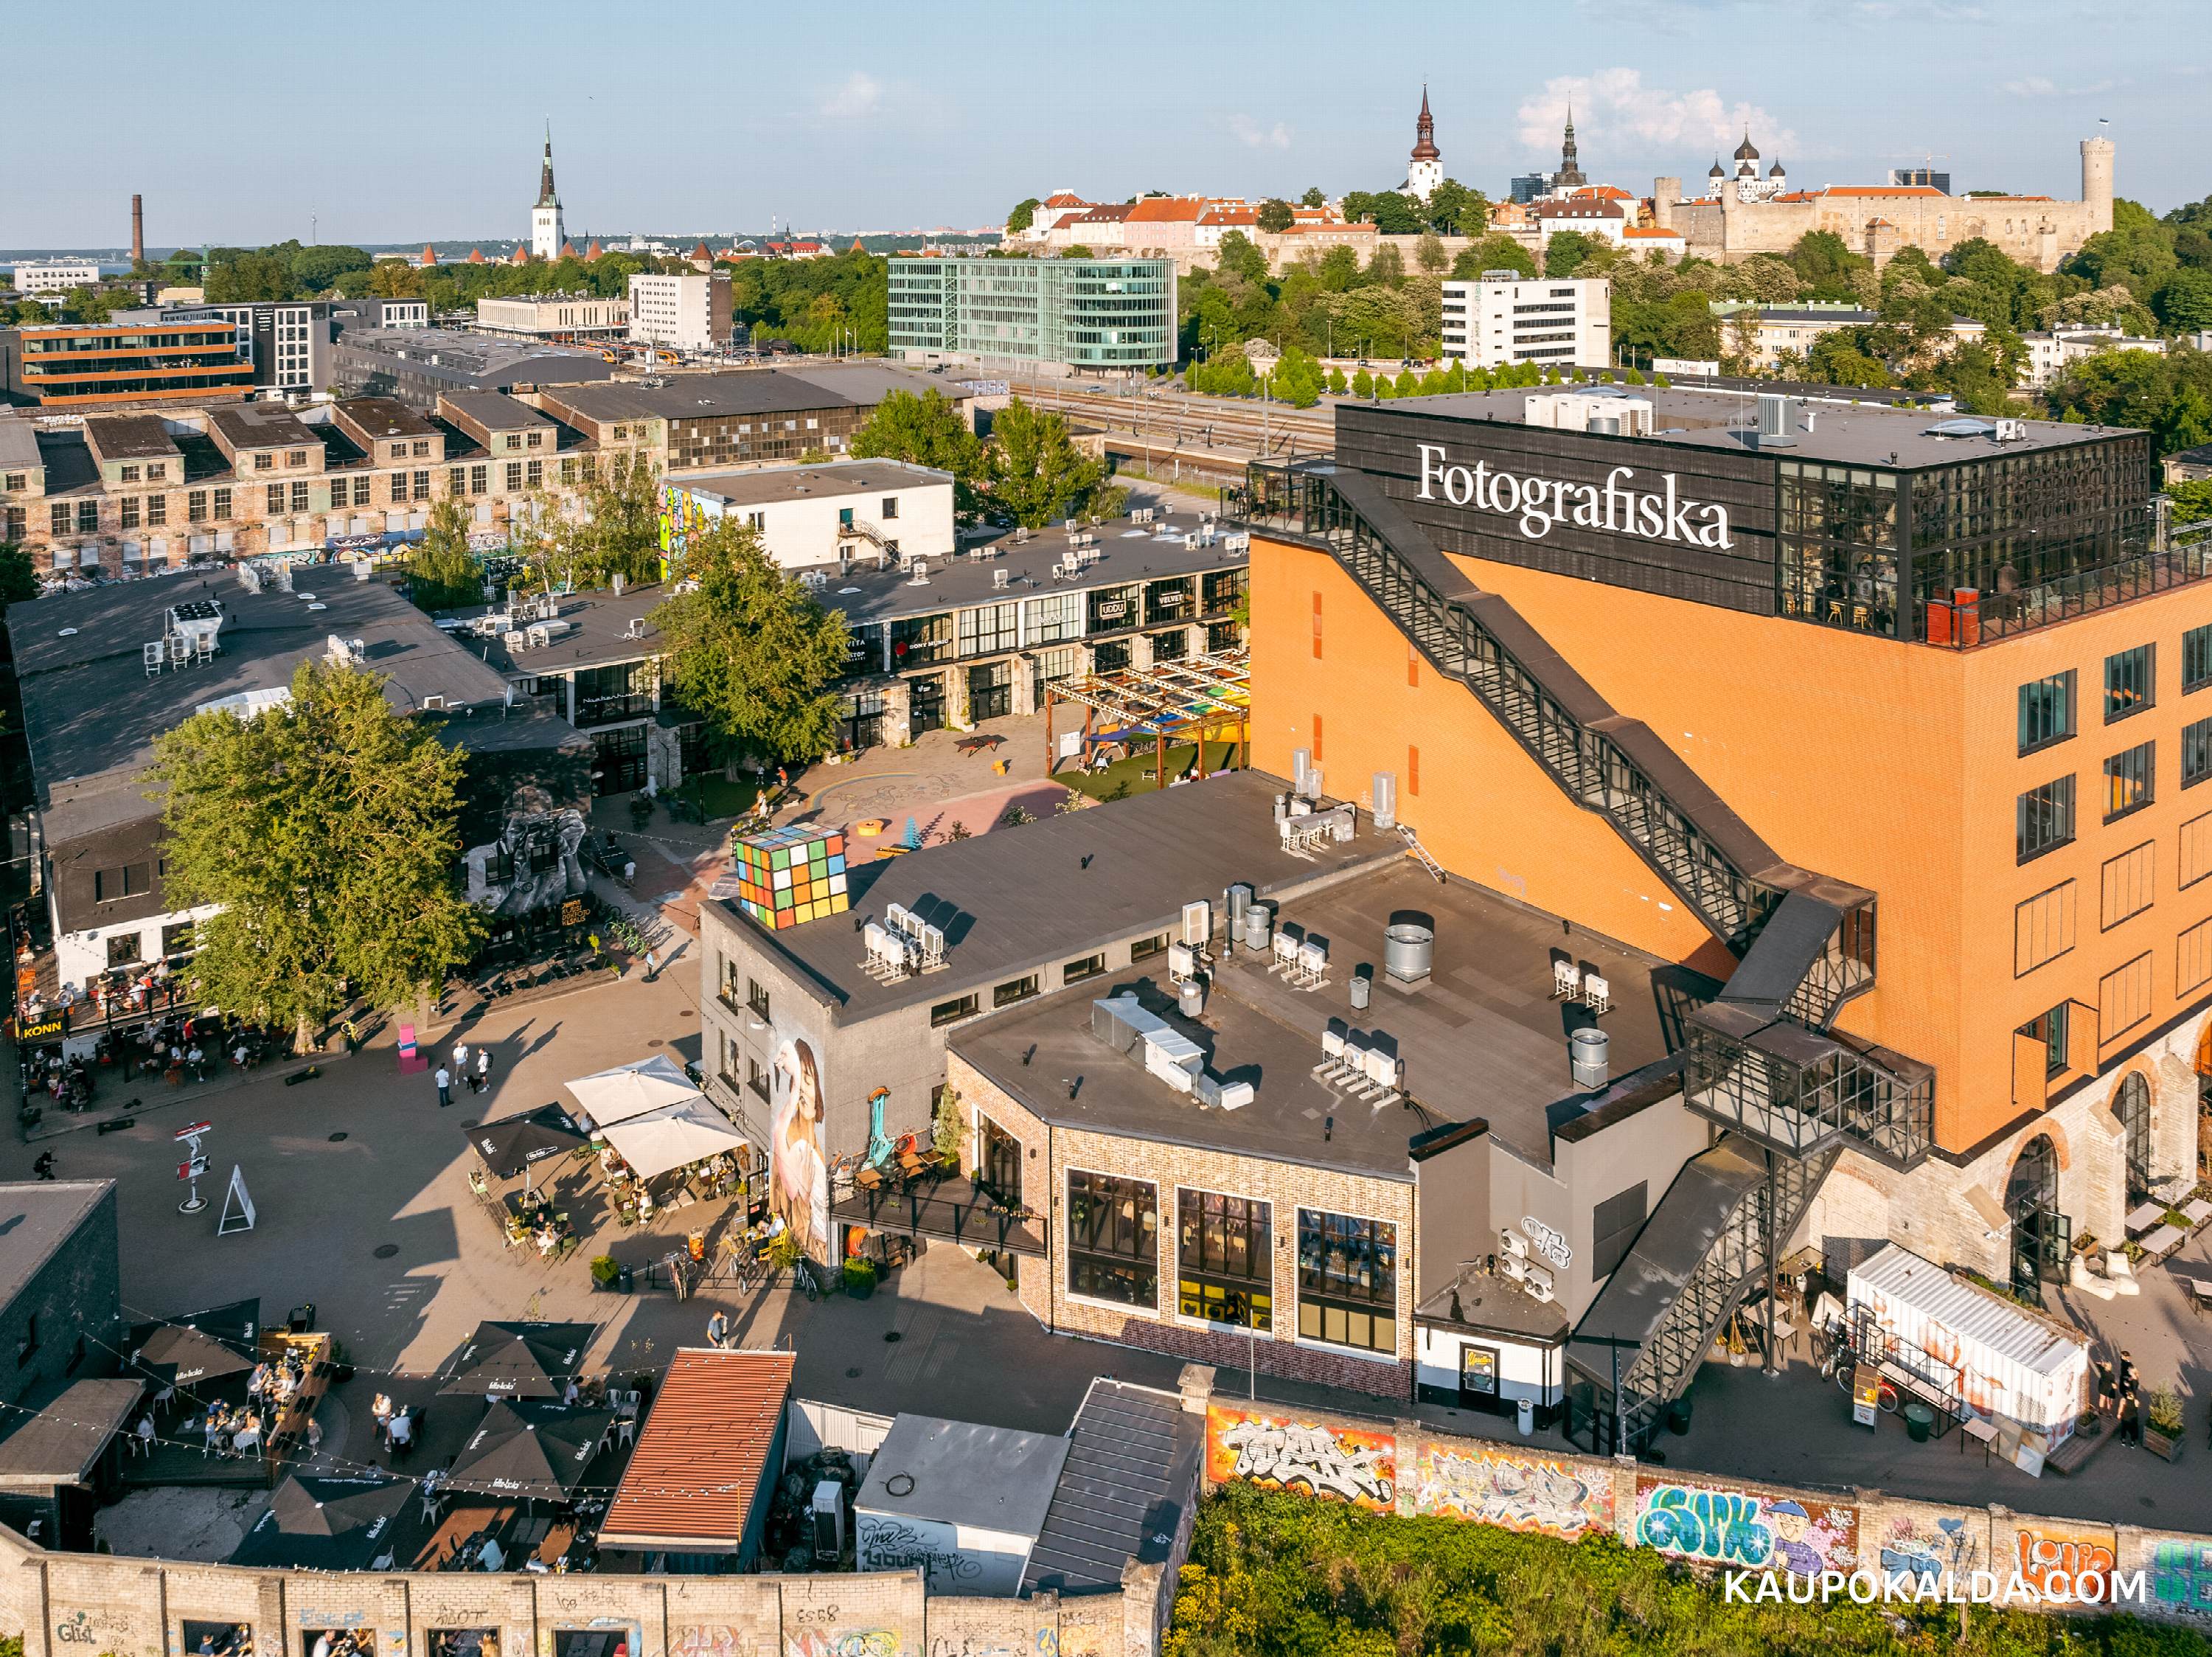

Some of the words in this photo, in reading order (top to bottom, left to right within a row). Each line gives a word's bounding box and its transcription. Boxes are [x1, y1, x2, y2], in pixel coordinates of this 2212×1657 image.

[1416, 444, 1735, 550] Fotografiska
[1158, 594, 1183, 605] VELVET
[1102, 603, 1124, 614] UDDU
[909, 642, 928, 650] SONY
[928, 639, 949, 647] MUSIC
[24, 1021, 62, 1038] KONN
